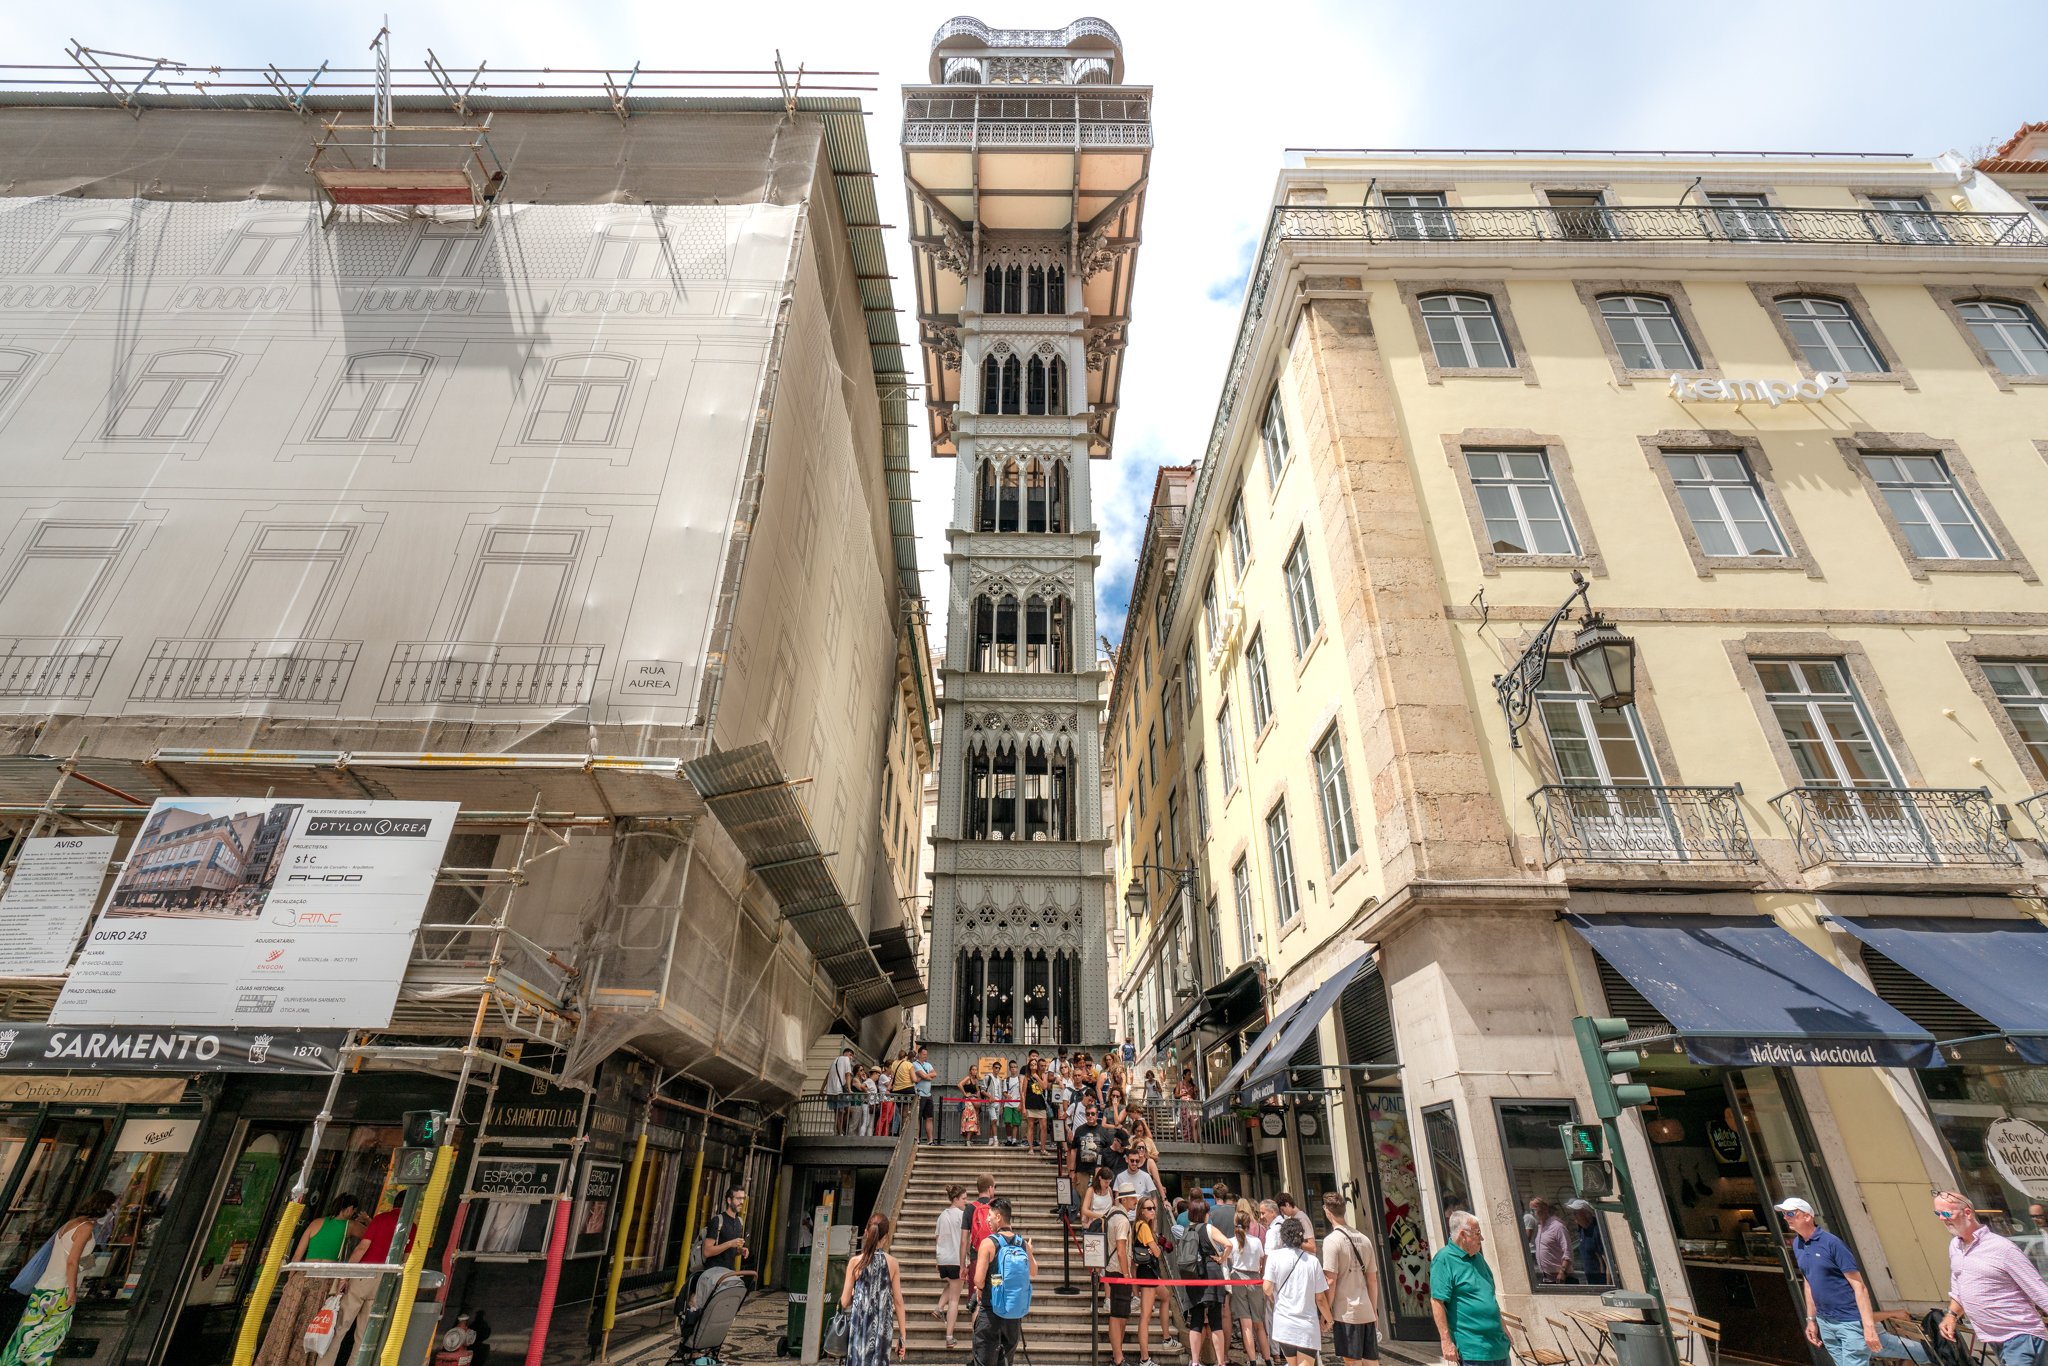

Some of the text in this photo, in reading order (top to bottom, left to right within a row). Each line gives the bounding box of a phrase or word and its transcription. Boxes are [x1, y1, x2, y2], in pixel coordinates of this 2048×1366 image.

[1669, 372, 1825, 409] tempo
[639, 666, 666, 675] RUA
[628, 679, 671, 689] AUREA
[309, 822, 427, 832] OPTYLON KREA
[54, 840, 83, 849] AVISO
[94, 931, 148, 941] OURO 243
[44, 1031, 220, 1060] SARMENTO
[292, 1046, 322, 1057] 1870
[1750, 1042, 1877, 1064] Nataria Nacional
[63, 1081, 105, 1098] Jomil
[143, 1126, 177, 1145] Persol
[423, 1120, 433, 1139] 5
[2001, 1128, 2034, 1145] forno
[483, 1170, 533, 1186] ESPAÇO
